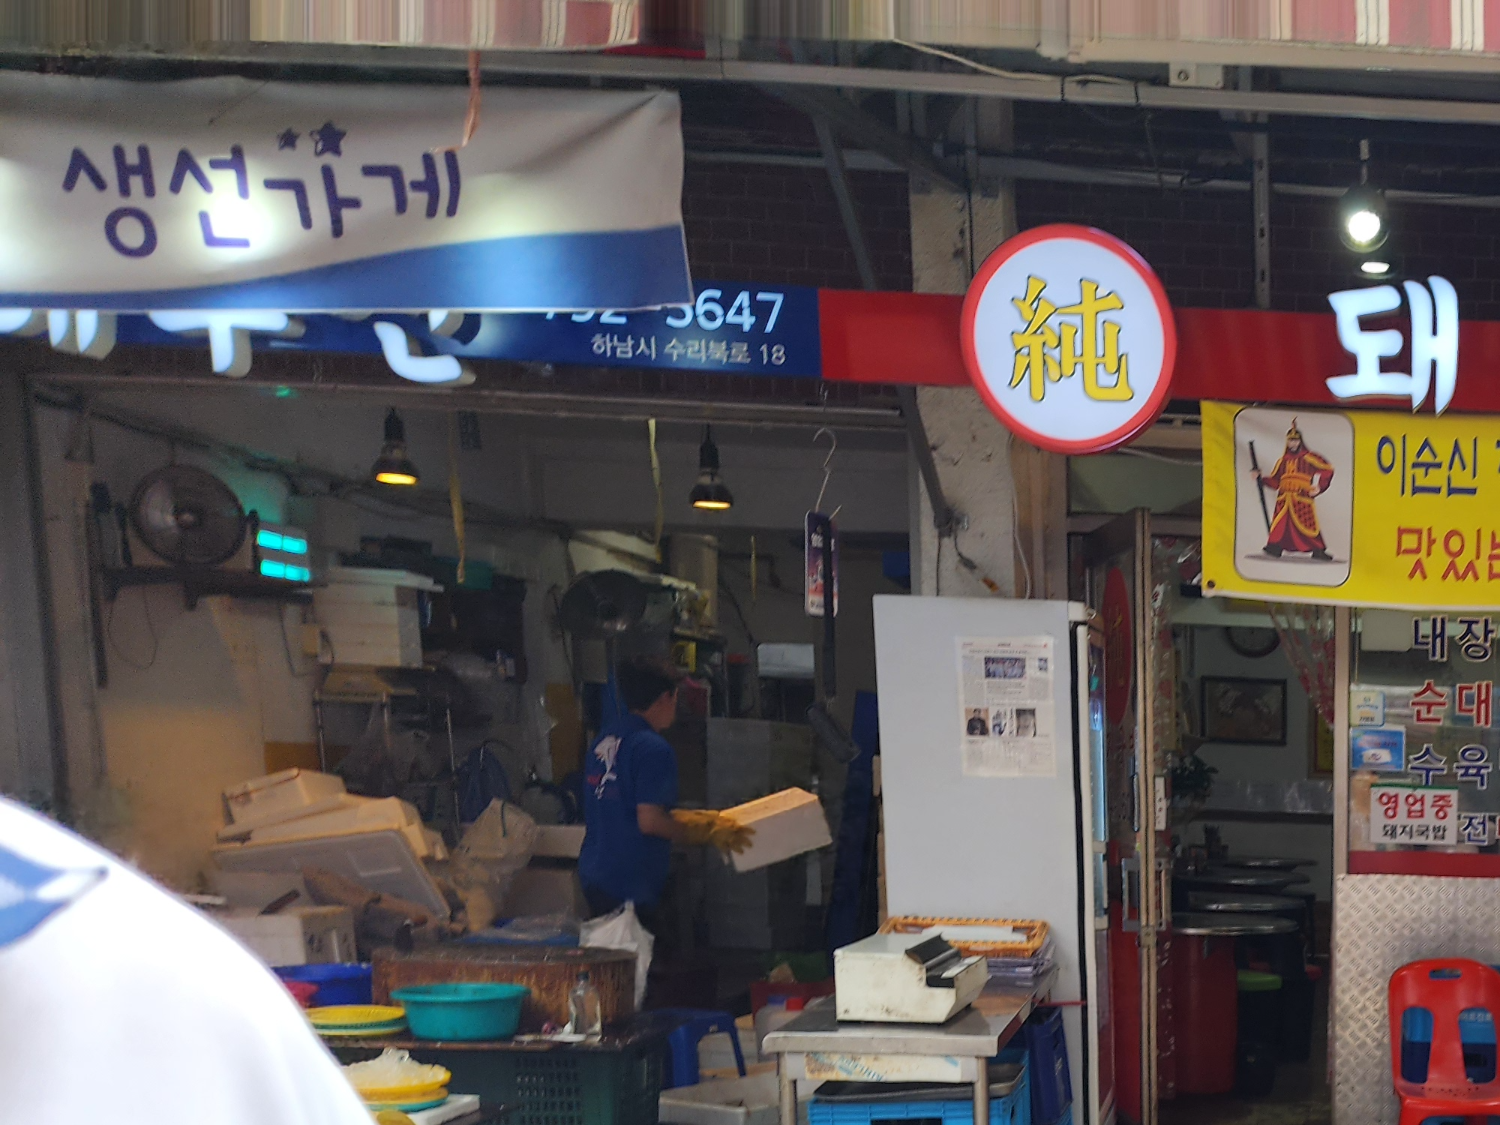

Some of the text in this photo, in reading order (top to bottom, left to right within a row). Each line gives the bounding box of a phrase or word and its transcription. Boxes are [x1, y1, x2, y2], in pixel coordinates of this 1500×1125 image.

[62, 143, 461, 258] 생선가게
[591, 332, 657, 361] 하남시
[759, 343, 786, 366] 18
[1008, 275, 1135, 403] 純
[1376, 433, 1478, 499] 이순신
[1378, 791, 1453, 821] 영업중
